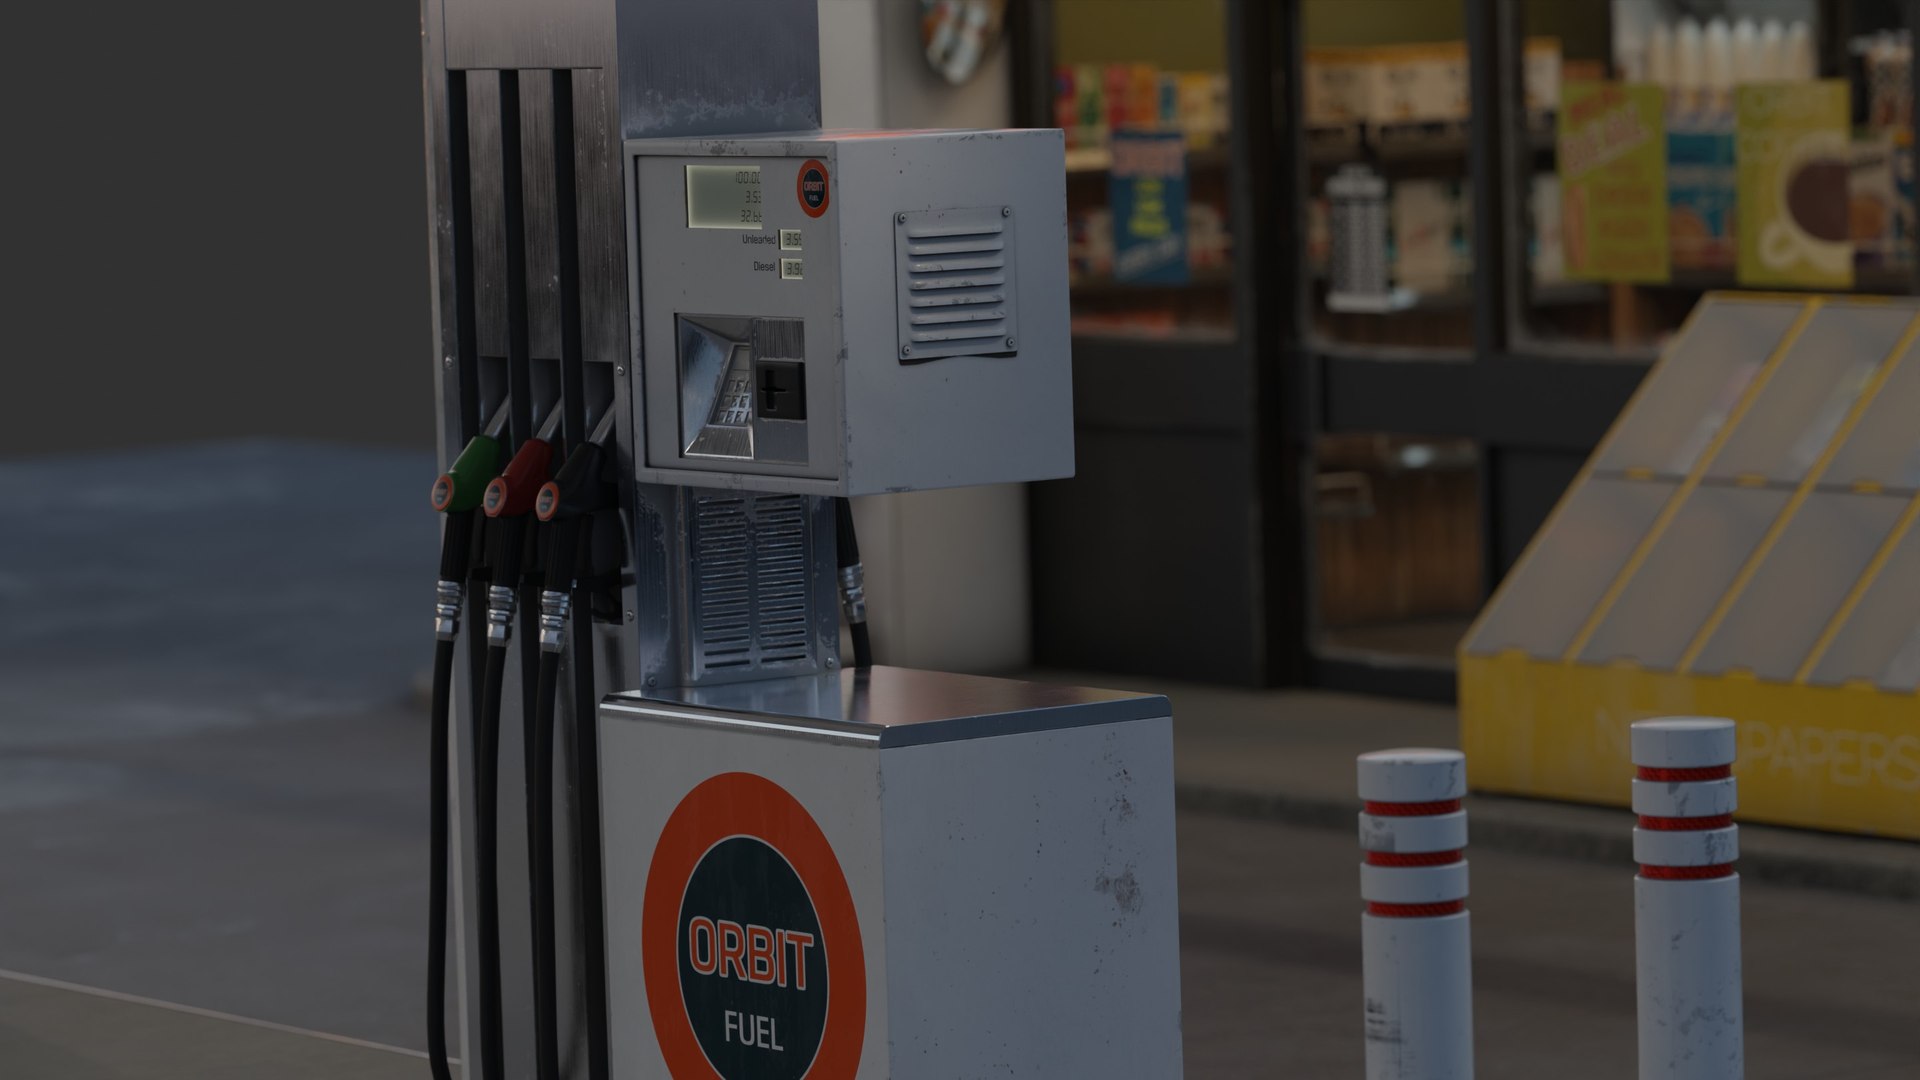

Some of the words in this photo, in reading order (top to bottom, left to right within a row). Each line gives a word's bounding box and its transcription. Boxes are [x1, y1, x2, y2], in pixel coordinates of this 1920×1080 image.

[804, 182, 824, 192] ORBIT
[753, 261, 776, 272] Diesel
[1594, 706, 1920, 790] NPAPERS
[688, 915, 816, 992] ORBIT
[724, 1009, 784, 1052] FUEL
